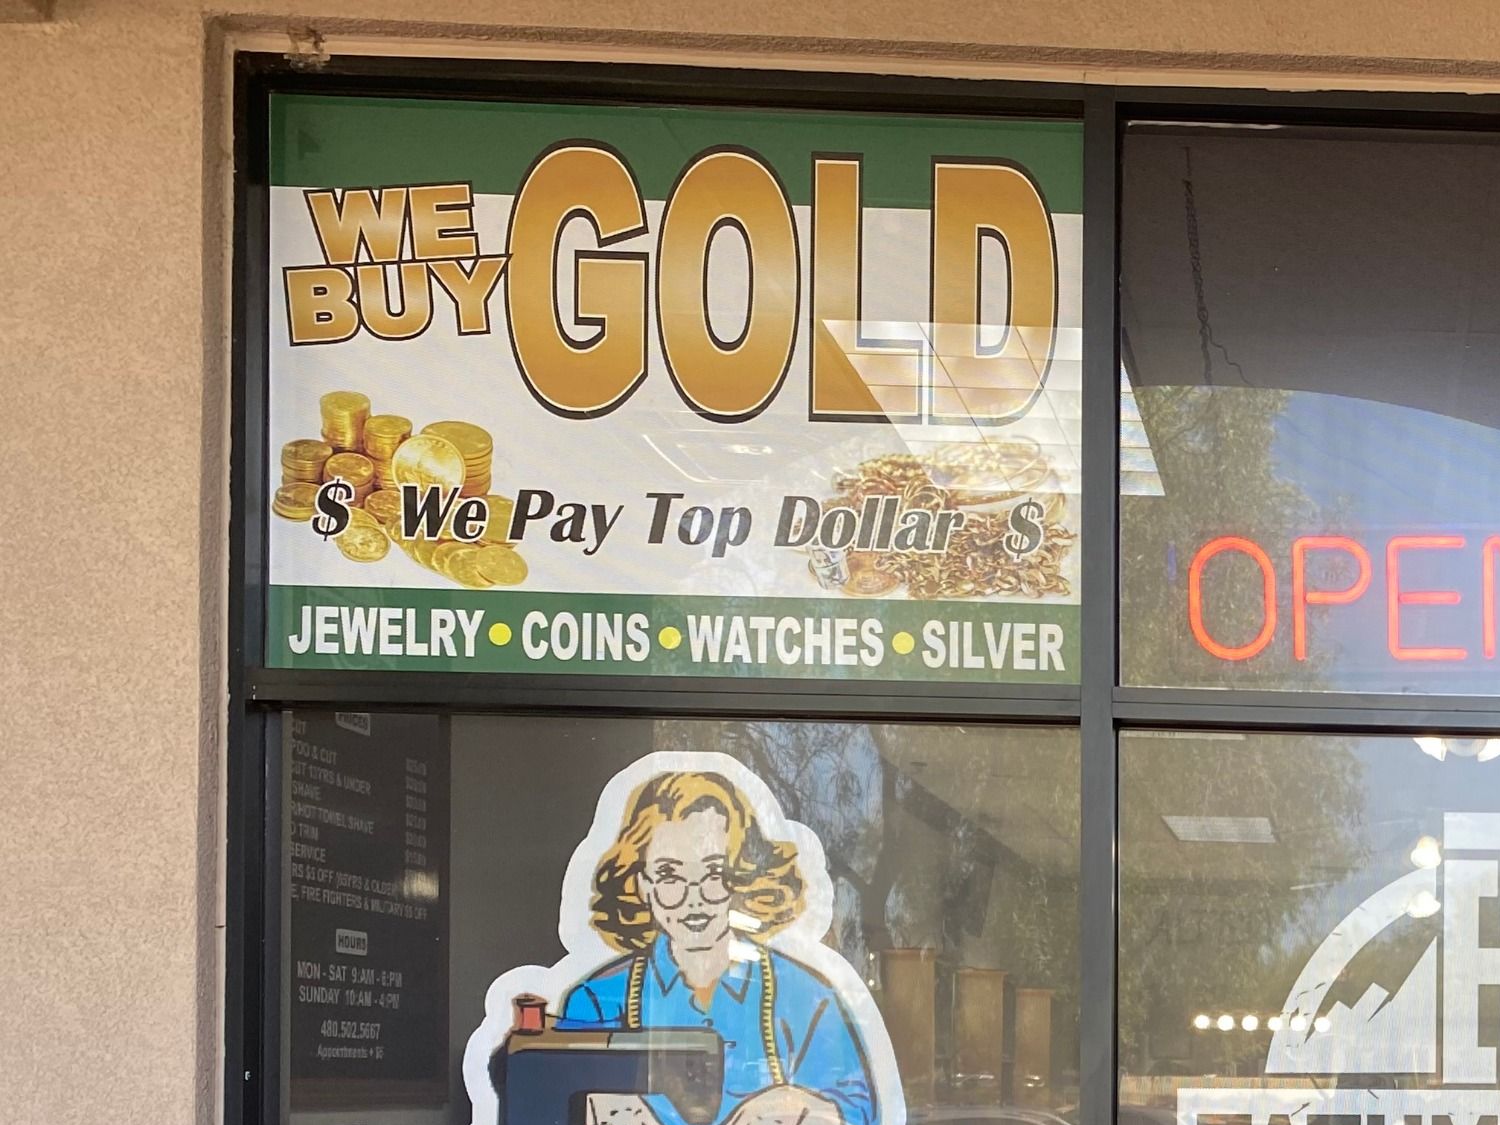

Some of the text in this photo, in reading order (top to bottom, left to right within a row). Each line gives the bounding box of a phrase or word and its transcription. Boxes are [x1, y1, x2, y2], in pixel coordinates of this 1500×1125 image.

[304, 181, 479, 266] WE
[282, 252, 511, 347] BUY
[505, 138, 1059, 428] GOLD
[312, 480, 1045, 563] $ We Pay Top Dollar $
[288, 604, 1066, 673] JEWELRY COINS WATCHES SILVER
[297, 961, 321, 980] MON
[328, 964, 347, 982] SAT
[338, 934, 367, 951] HOURS
[298, 985, 341, 1005] SUNDAY
